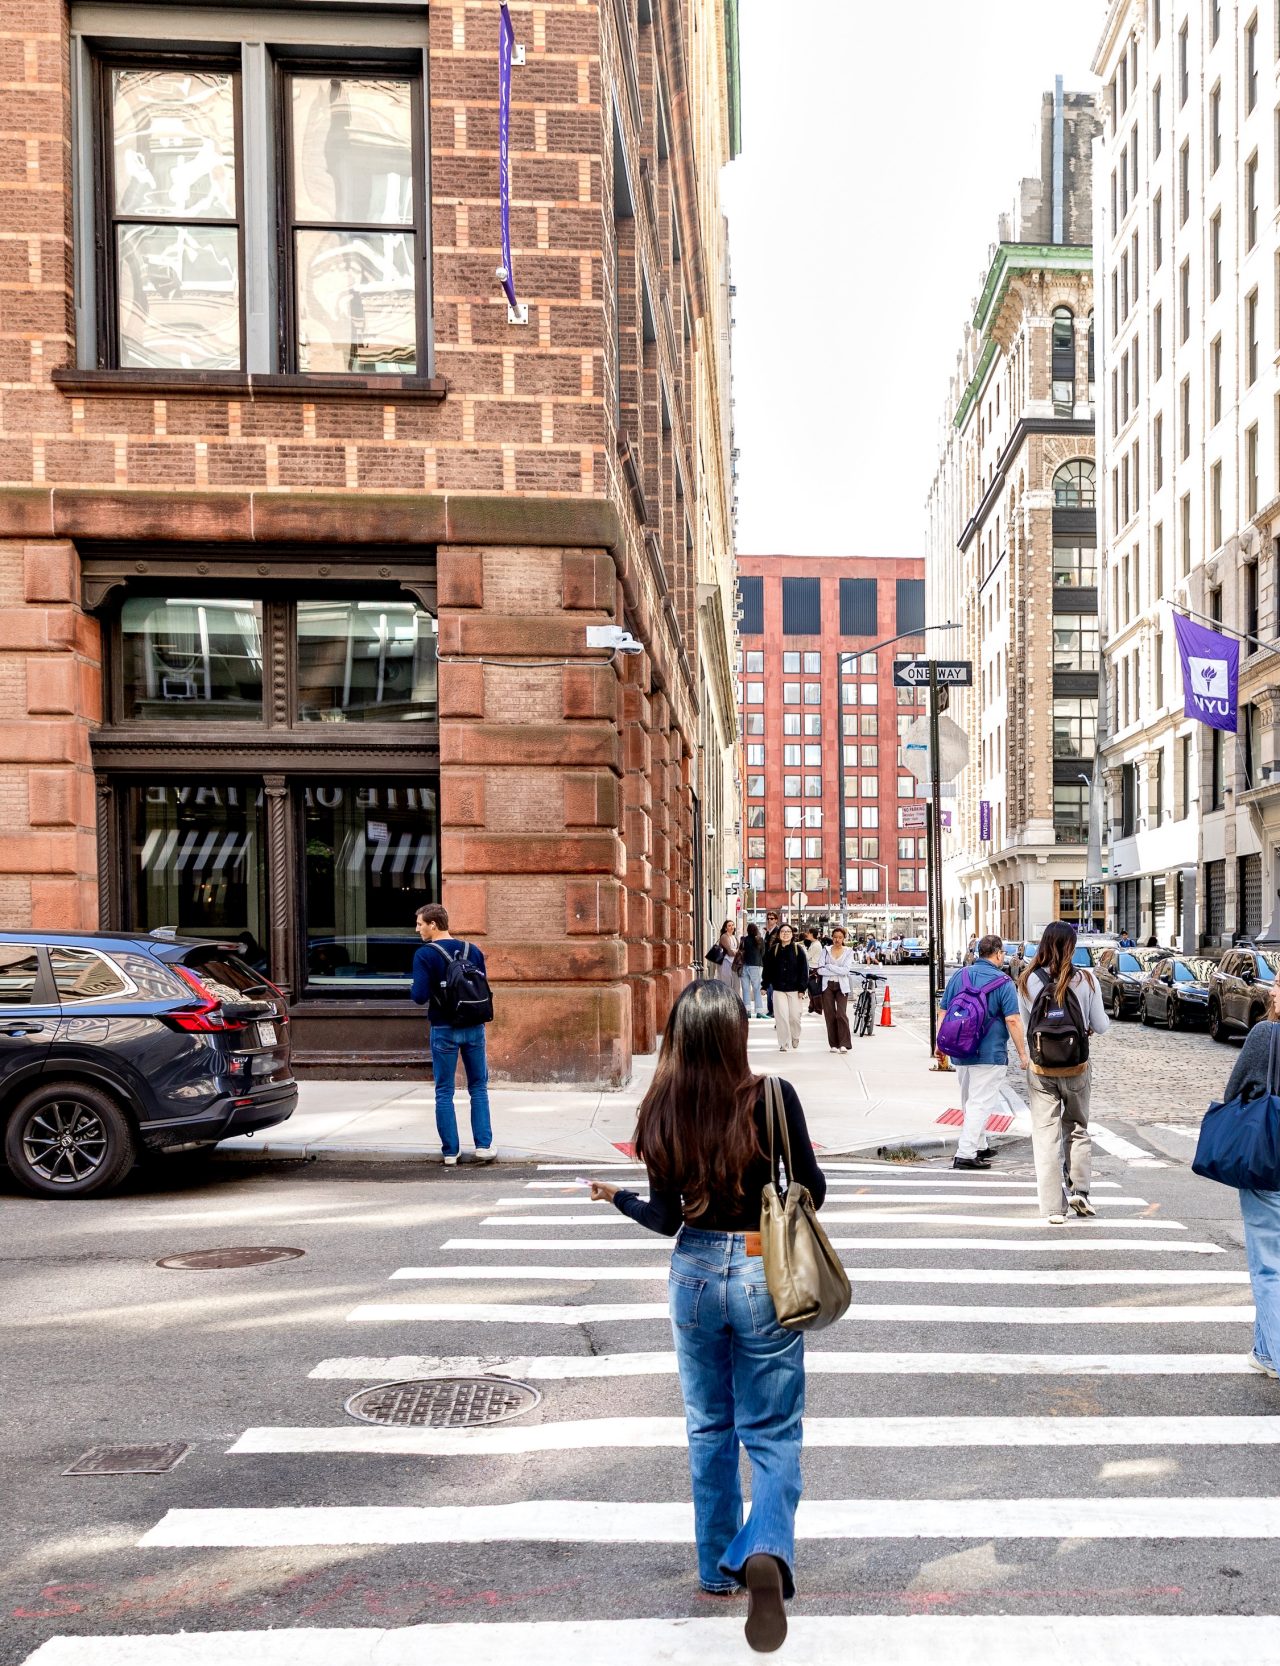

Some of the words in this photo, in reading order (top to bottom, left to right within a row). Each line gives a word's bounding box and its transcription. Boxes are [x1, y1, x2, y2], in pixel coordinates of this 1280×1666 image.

[908, 668, 930, 679] ONE
[937, 668, 962, 679] WAY
[1194, 694, 1230, 716] NYU
